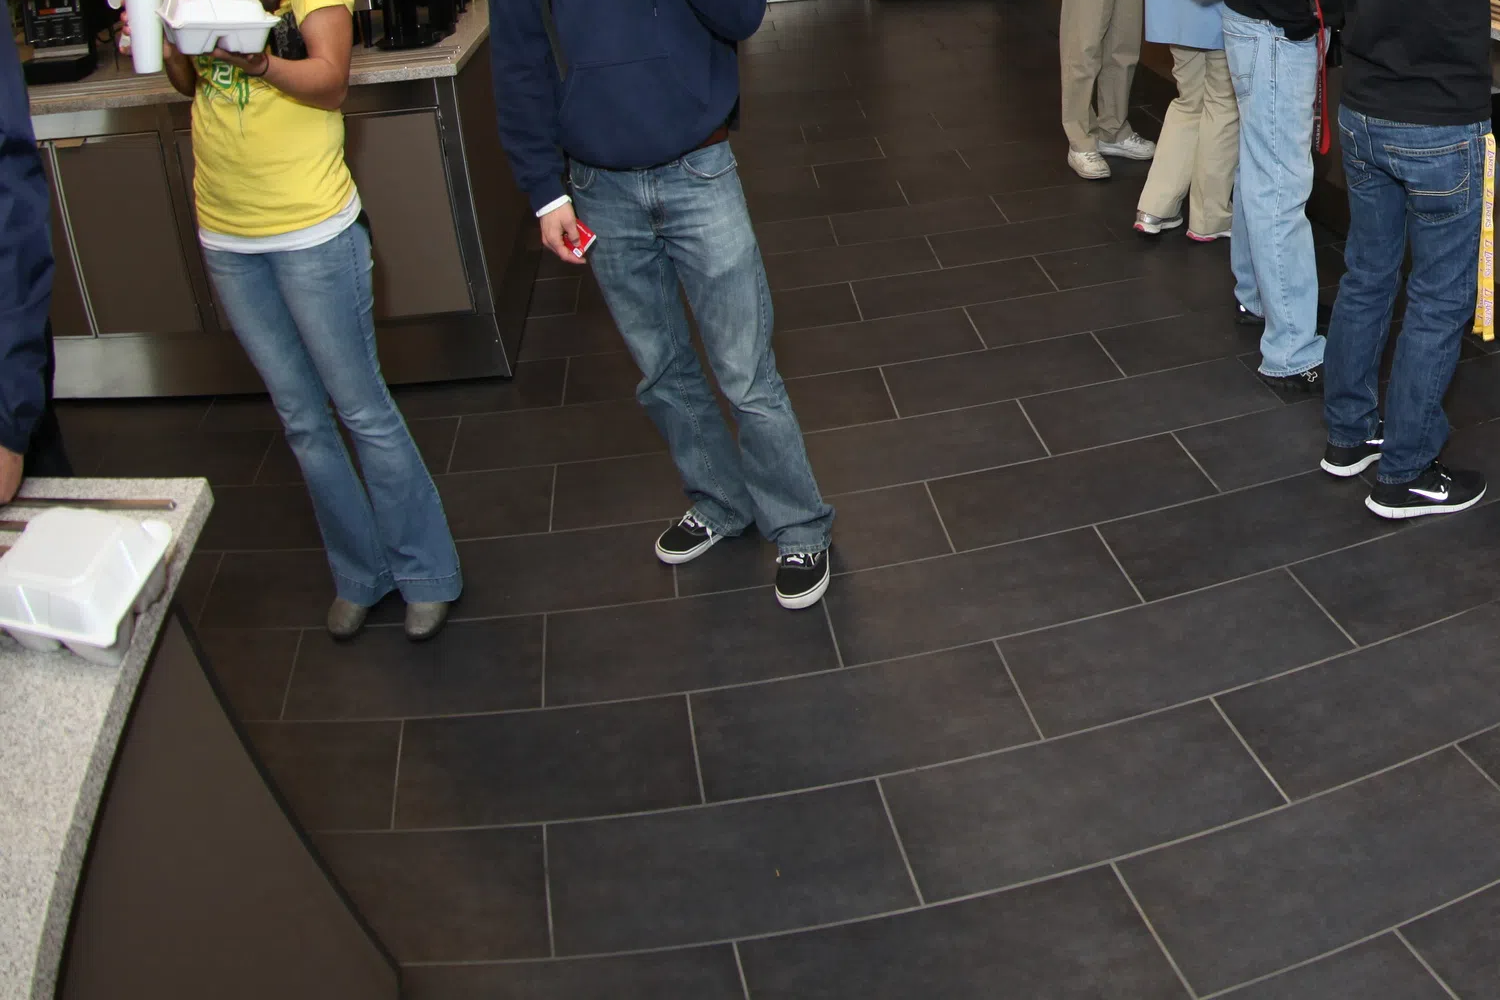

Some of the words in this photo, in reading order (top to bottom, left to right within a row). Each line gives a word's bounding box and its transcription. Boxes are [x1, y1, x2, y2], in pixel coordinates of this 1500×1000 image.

[1487, 150, 1495, 177] LAKERS
[1485, 201, 1493, 228] LAKERS
[1484, 250, 1493, 277] LAKERS
[1484, 300, 1493, 326] LAKERS
